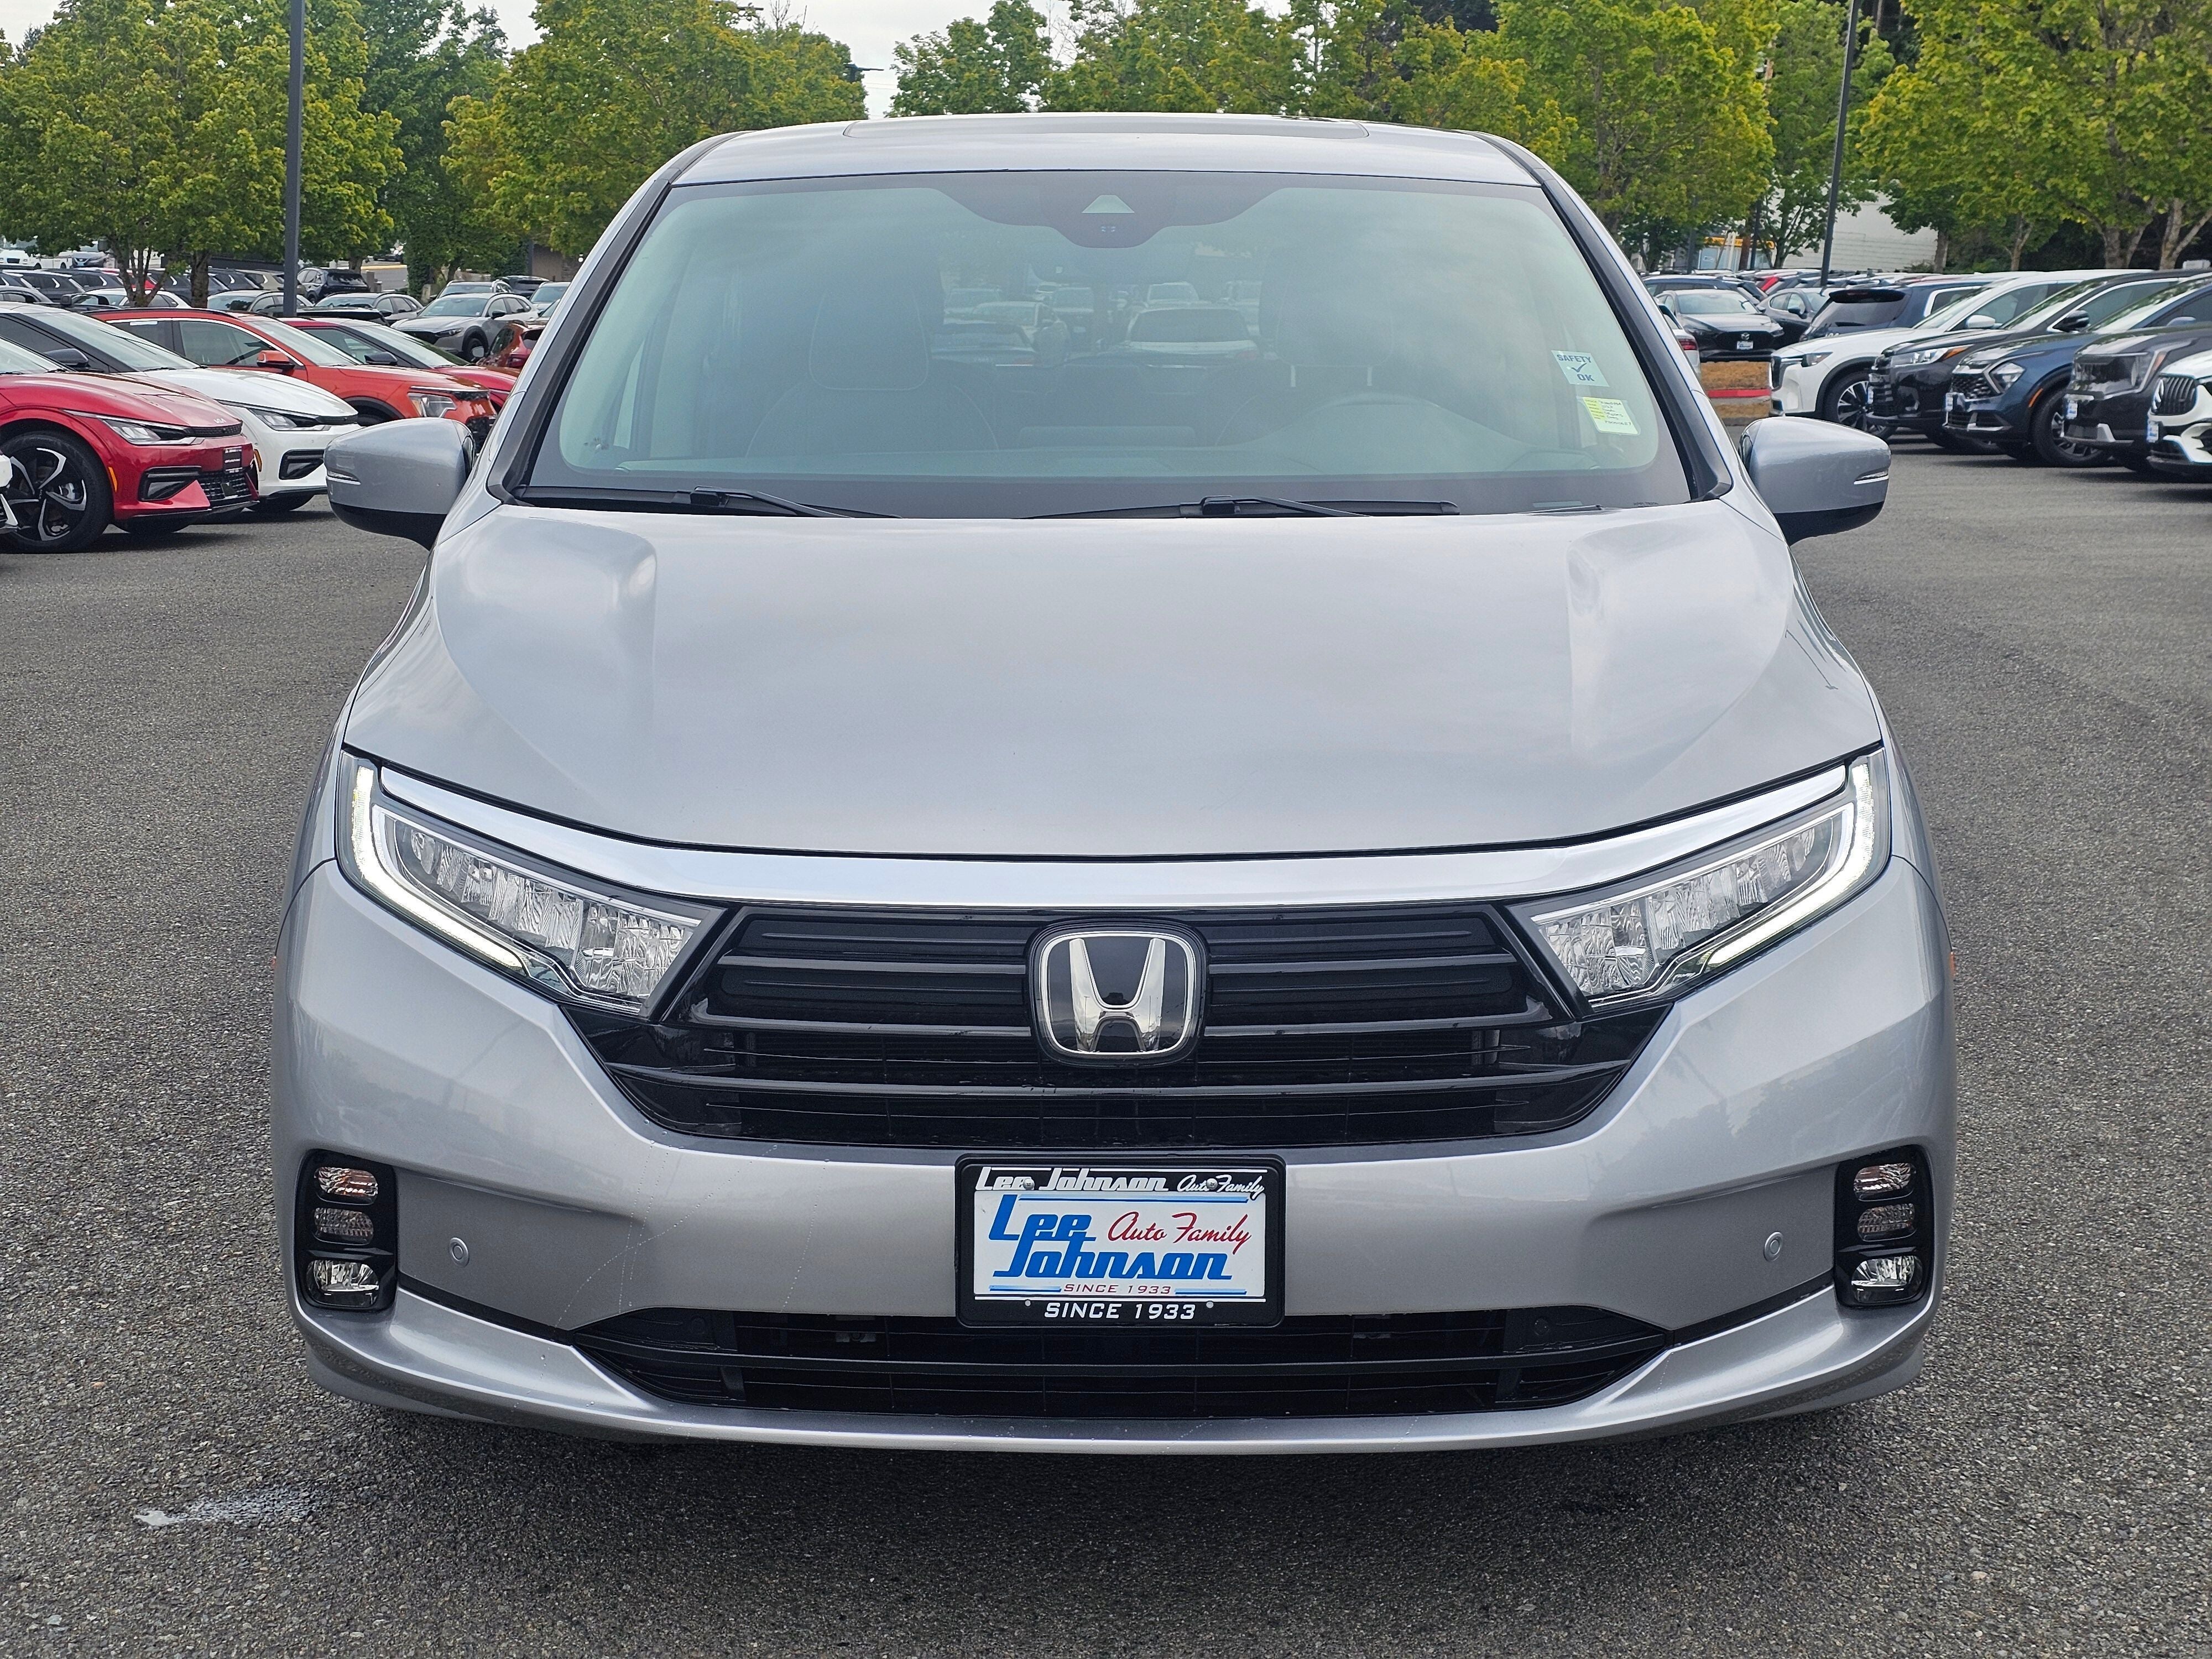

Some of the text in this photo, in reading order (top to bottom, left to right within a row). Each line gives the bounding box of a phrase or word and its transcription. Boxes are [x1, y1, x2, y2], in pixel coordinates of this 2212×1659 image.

[1557, 354, 1592, 363] SAFETY
[1038, 1167, 1168, 1191] Johnson
[1177, 1174, 1216, 1192] Aut
[1215, 1174, 1265, 1199] Family
[988, 1194, 1097, 1241] Lee
[1108, 1211, 1252, 1255] Auto Family
[993, 1232, 1233, 1280] Johnson
[1063, 1284, 1171, 1294] SINCE 1933
[1044, 1302, 1196, 1319] SINCE 1933
